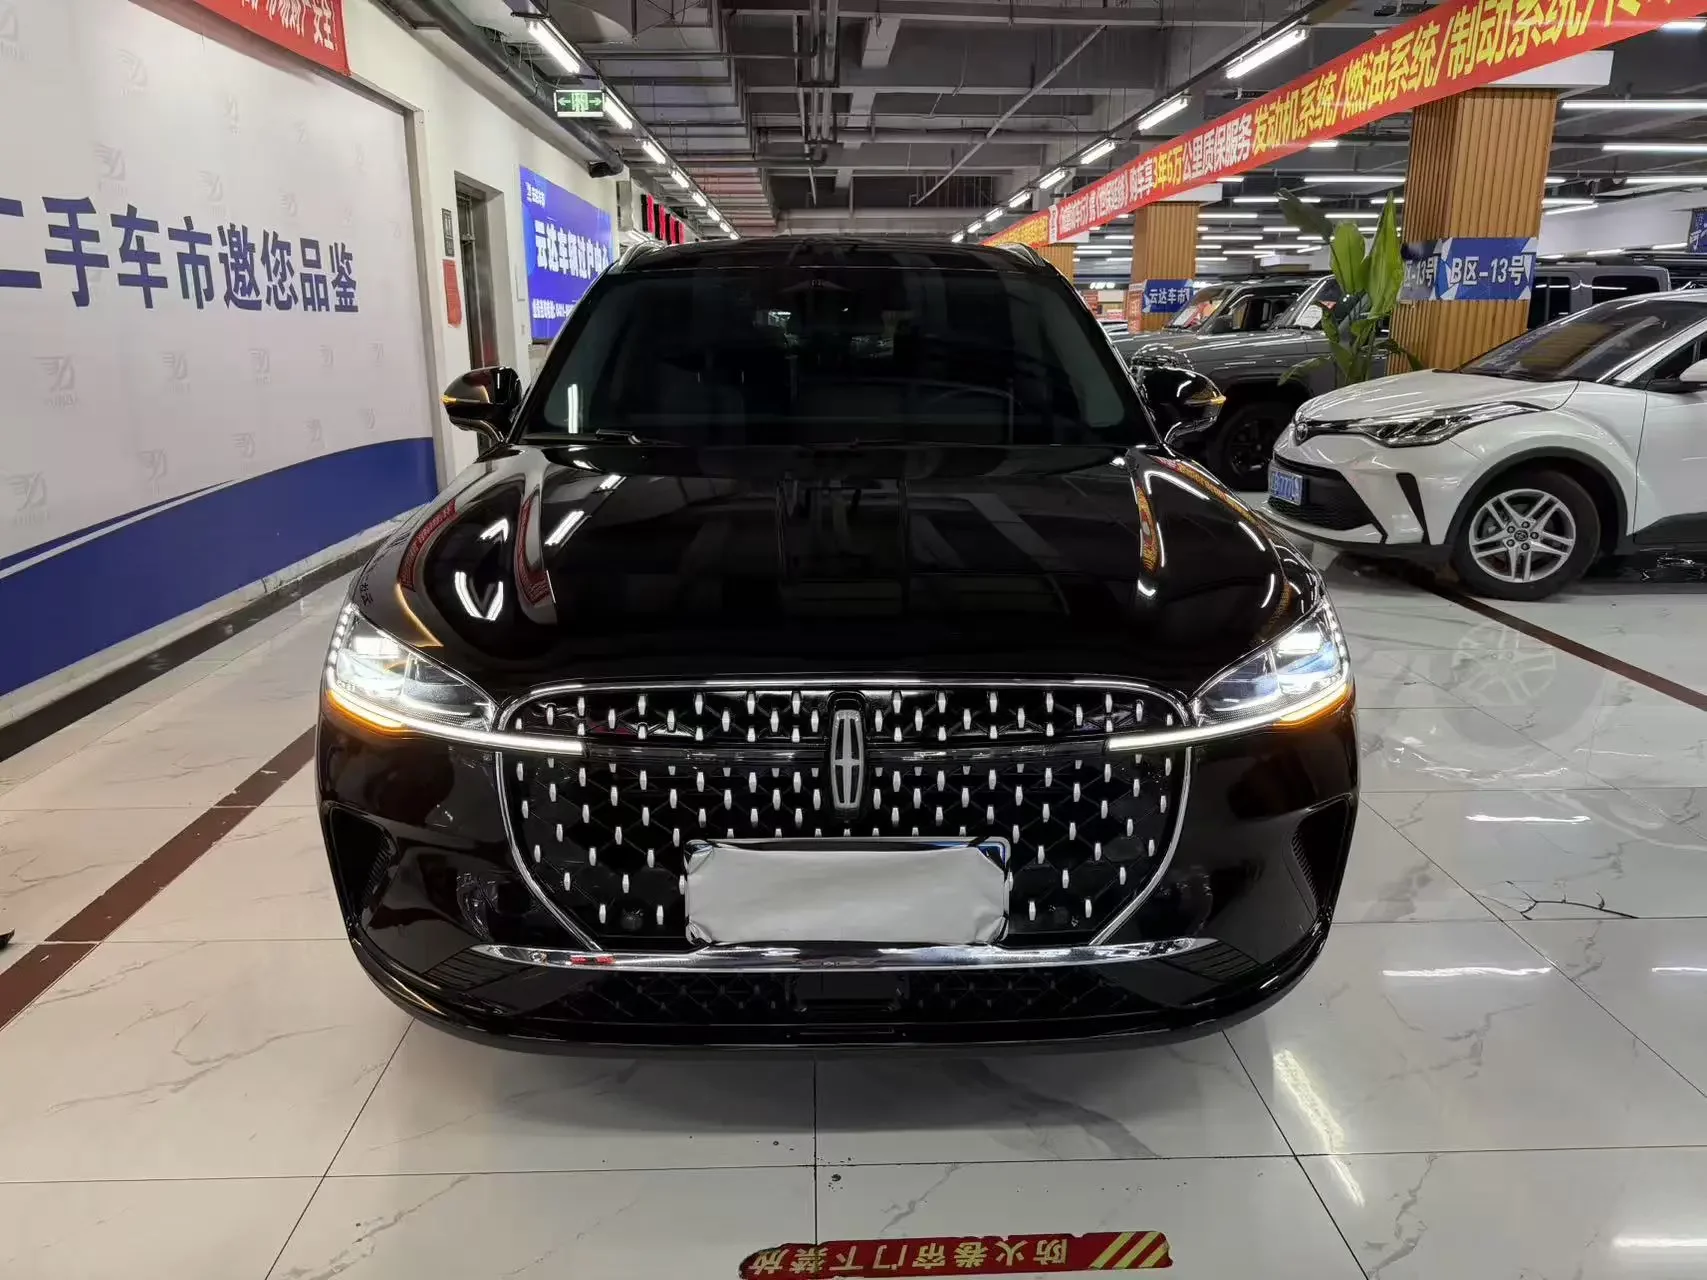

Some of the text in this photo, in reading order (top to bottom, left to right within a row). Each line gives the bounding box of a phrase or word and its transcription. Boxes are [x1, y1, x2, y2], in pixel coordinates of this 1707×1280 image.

[0, 196, 358, 312] 二手车市邀您品鉴
[1450, 256, 1525, 286] B区-13号
[1149, 288, 1188, 304] 云达车市
[750, 1238, 1068, 1275] 防火卷帘门下禁放
